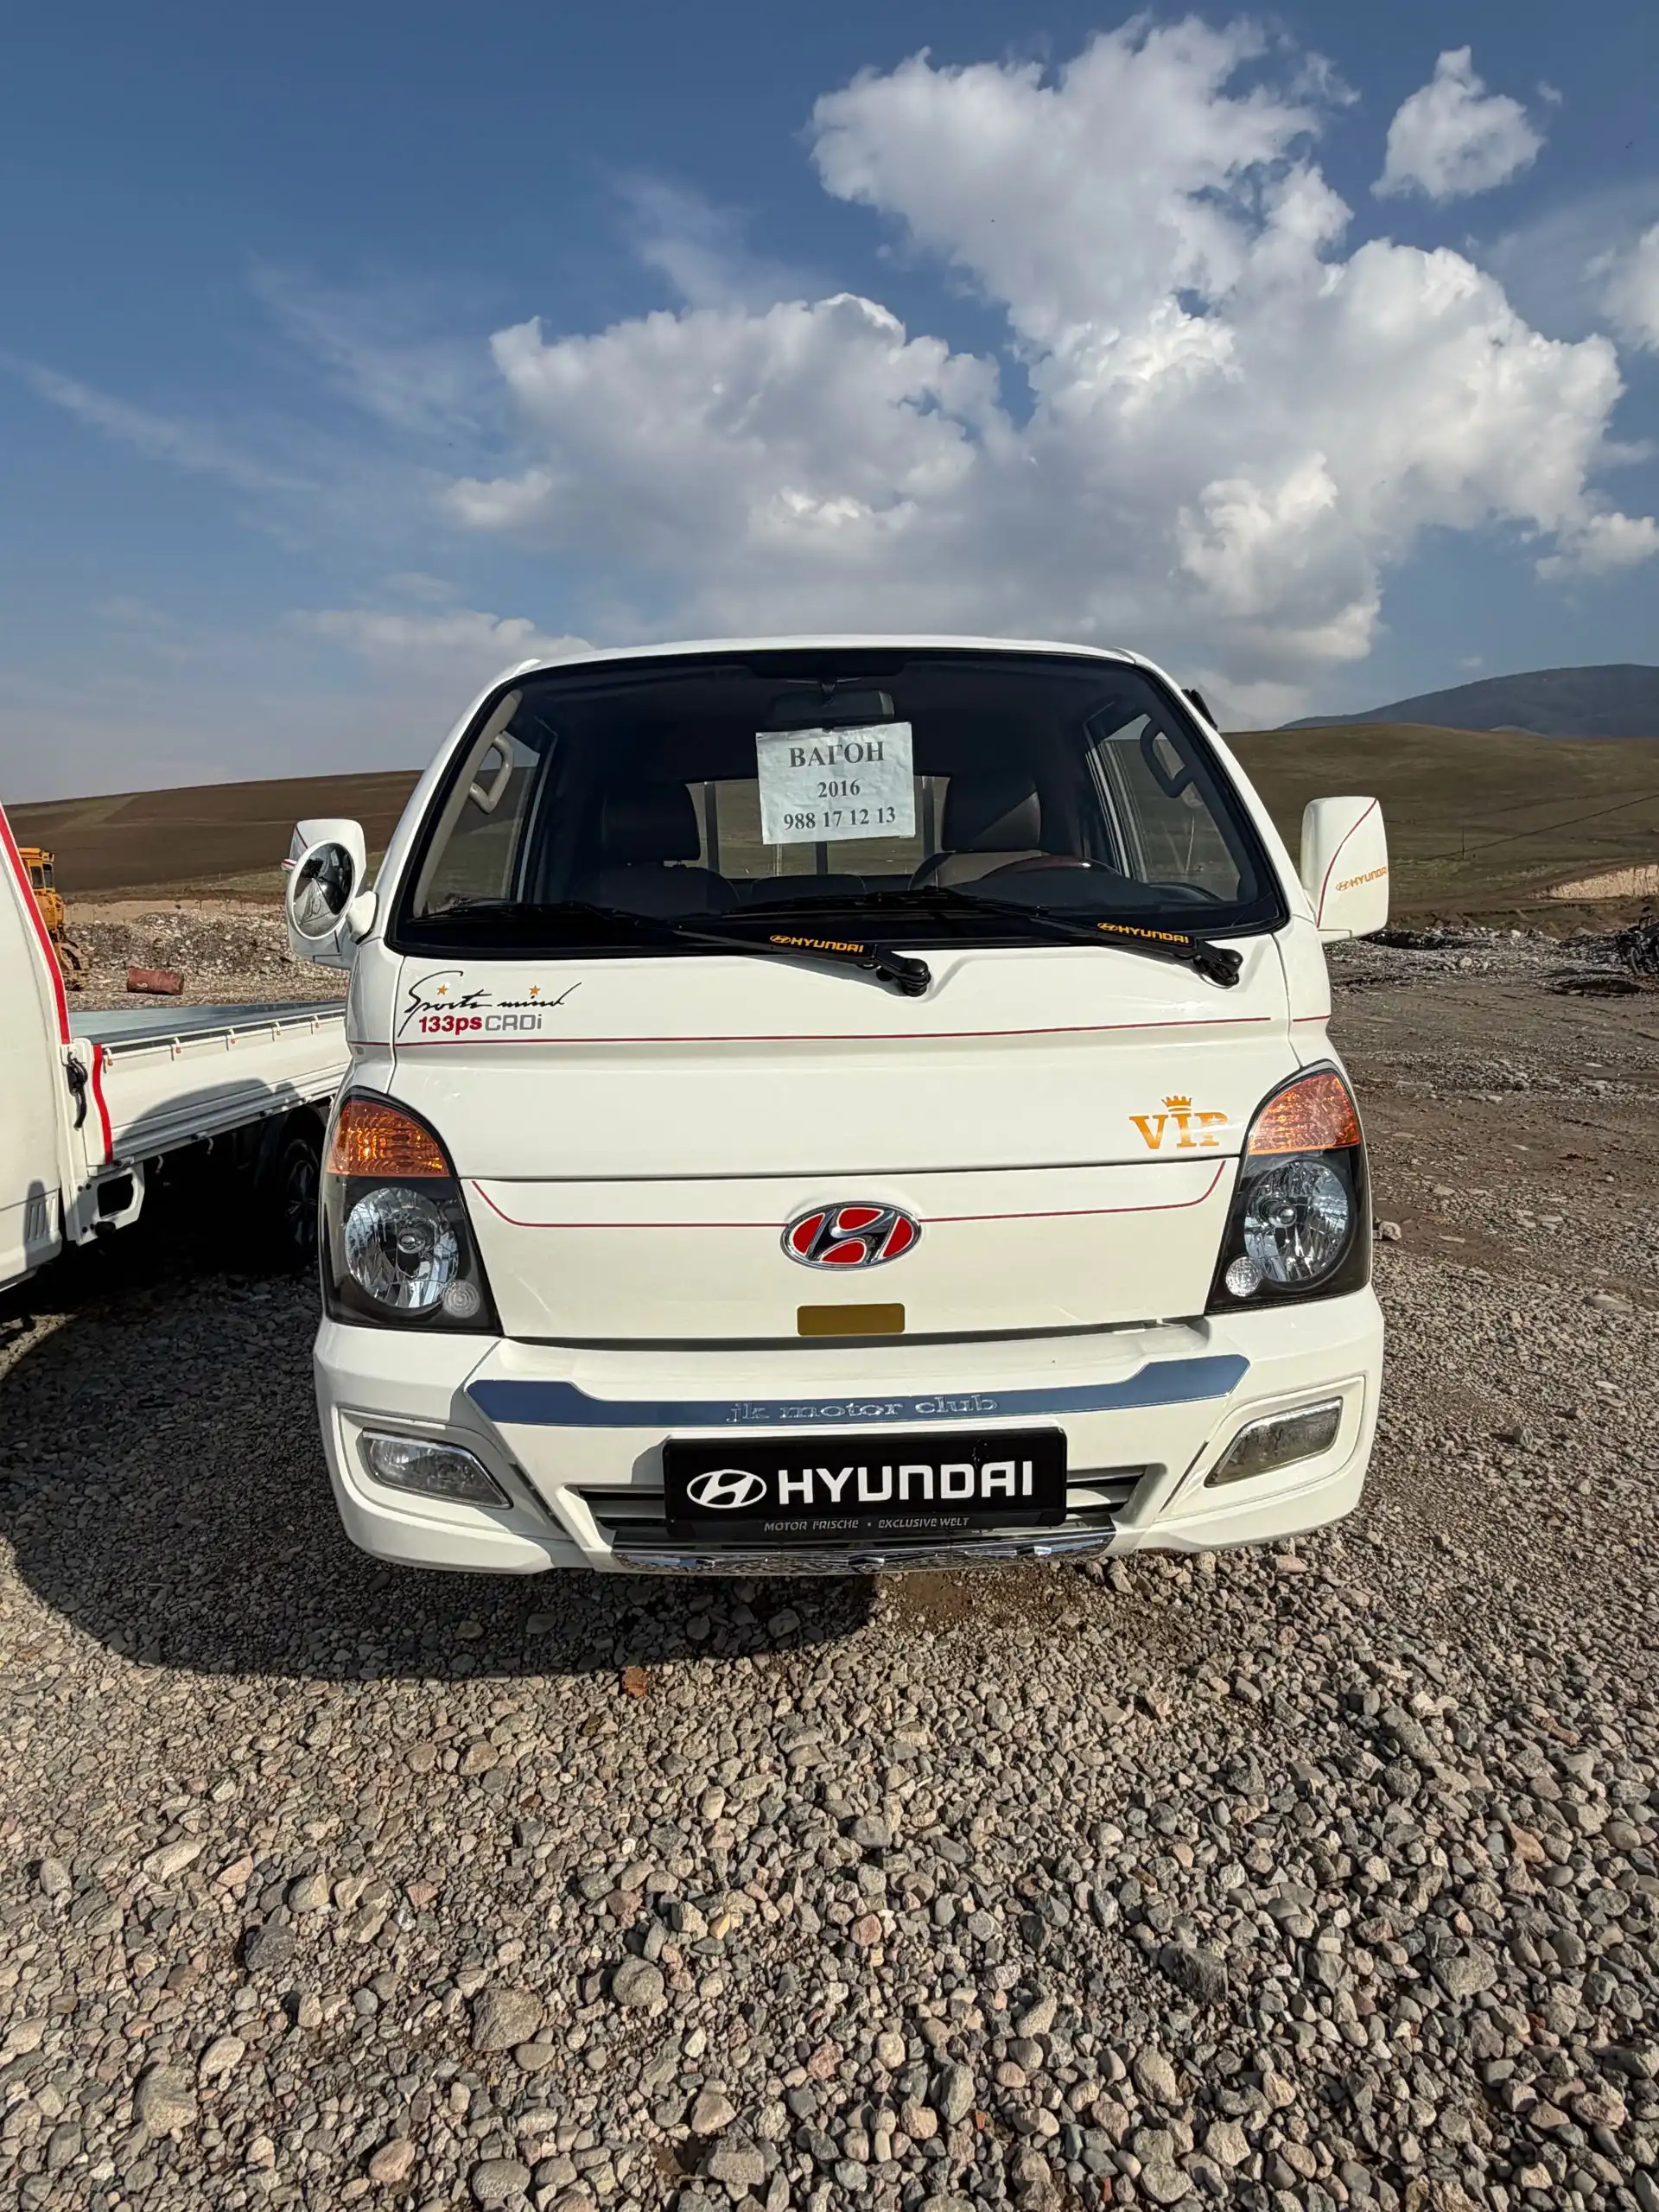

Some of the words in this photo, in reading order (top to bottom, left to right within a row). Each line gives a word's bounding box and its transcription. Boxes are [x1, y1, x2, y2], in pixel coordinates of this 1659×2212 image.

[788, 741, 885, 768] ВАГОН
[817, 779, 861, 798] 2016
[784, 812, 816, 830] 988
[823, 810, 842, 828] 17
[850, 809, 870, 825] 12
[877, 806, 896, 823] 13
[791, 937, 864, 952] HYUNDAI
[1118, 927, 1190, 944] HYUNDAI
[1128, 1112, 1229, 1149] VIP
[726, 1402, 769, 1423] jk
[779, 1402, 904, 1419] motor
[915, 1395, 998, 1414] club
[779, 1460, 1033, 1504] HYUNDAI
[764, 1521, 808, 1532] MOTOR
[812, 1519, 859, 1530] FRISCHE
[878, 1518, 938, 1529] EXCLUSIVE
[940, 1517, 969, 1527] WELT
